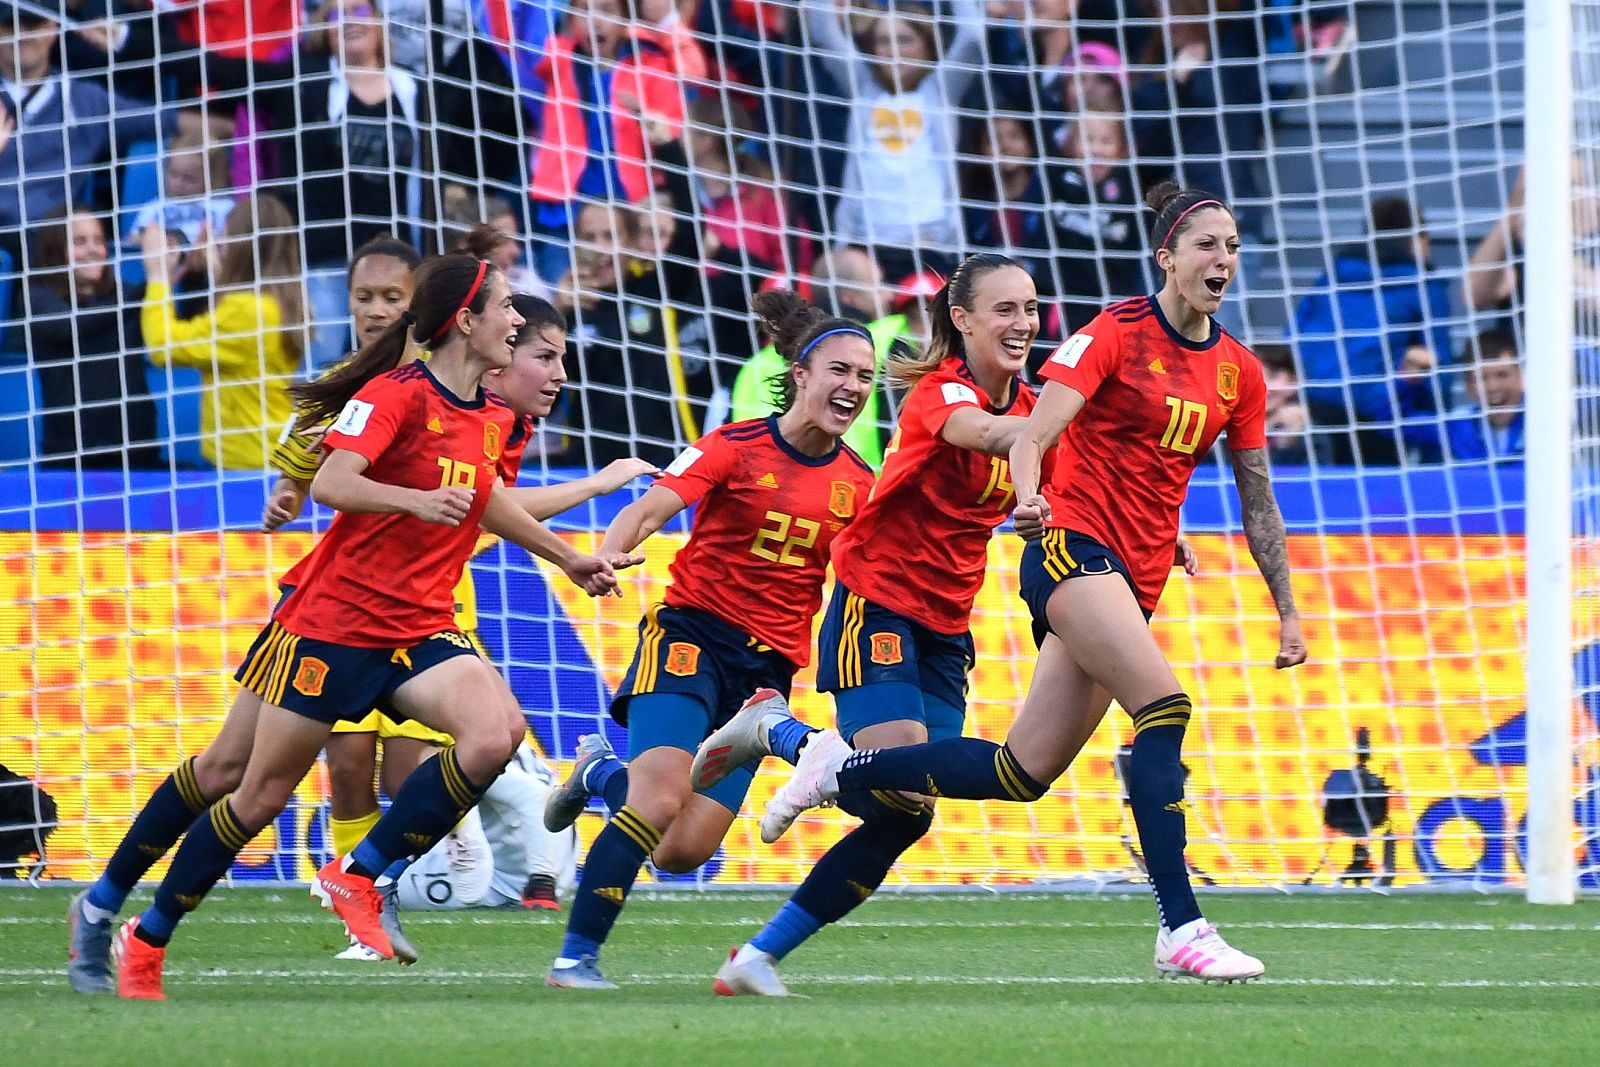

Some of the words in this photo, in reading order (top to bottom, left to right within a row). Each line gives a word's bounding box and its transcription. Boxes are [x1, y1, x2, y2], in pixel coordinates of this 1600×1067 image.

[1160, 395, 1208, 455] 10
[976, 456, 1015, 511] 14
[749, 510, 821, 567] 22
